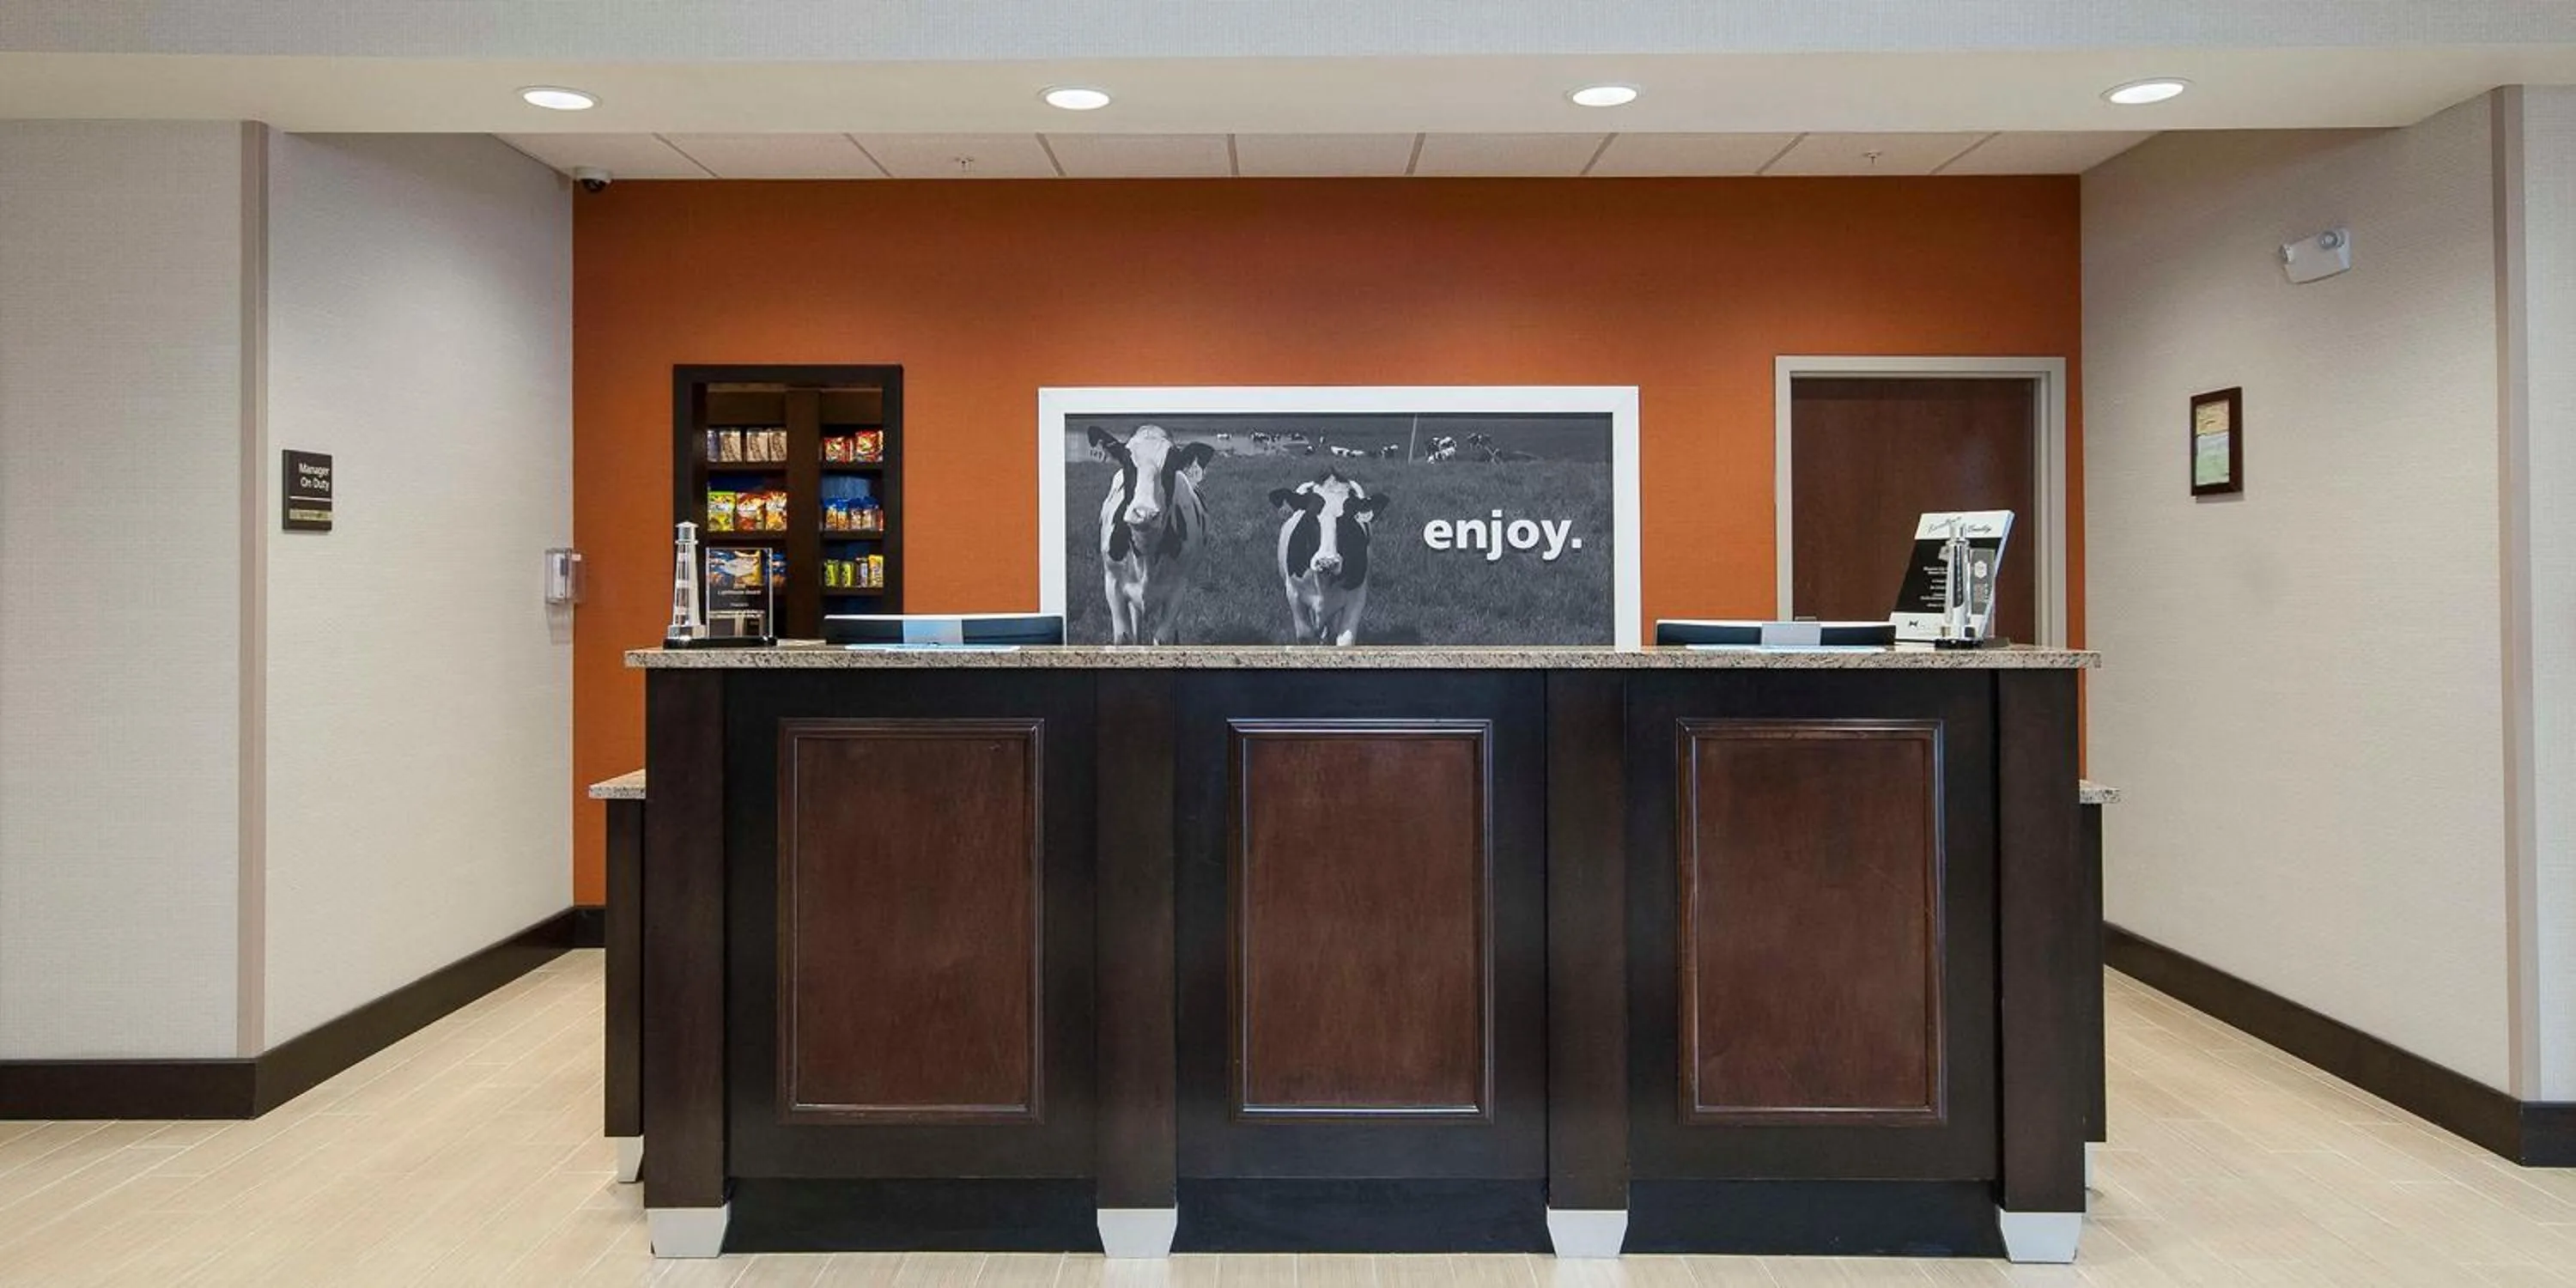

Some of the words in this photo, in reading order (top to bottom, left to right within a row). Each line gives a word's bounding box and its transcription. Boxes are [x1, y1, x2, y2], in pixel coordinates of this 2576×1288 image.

[299, 463, 330, 477] Manager
[301, 477, 312, 488] On
[313, 477, 330, 491] Duty
[1423, 509, 1583, 561] enjoy.
